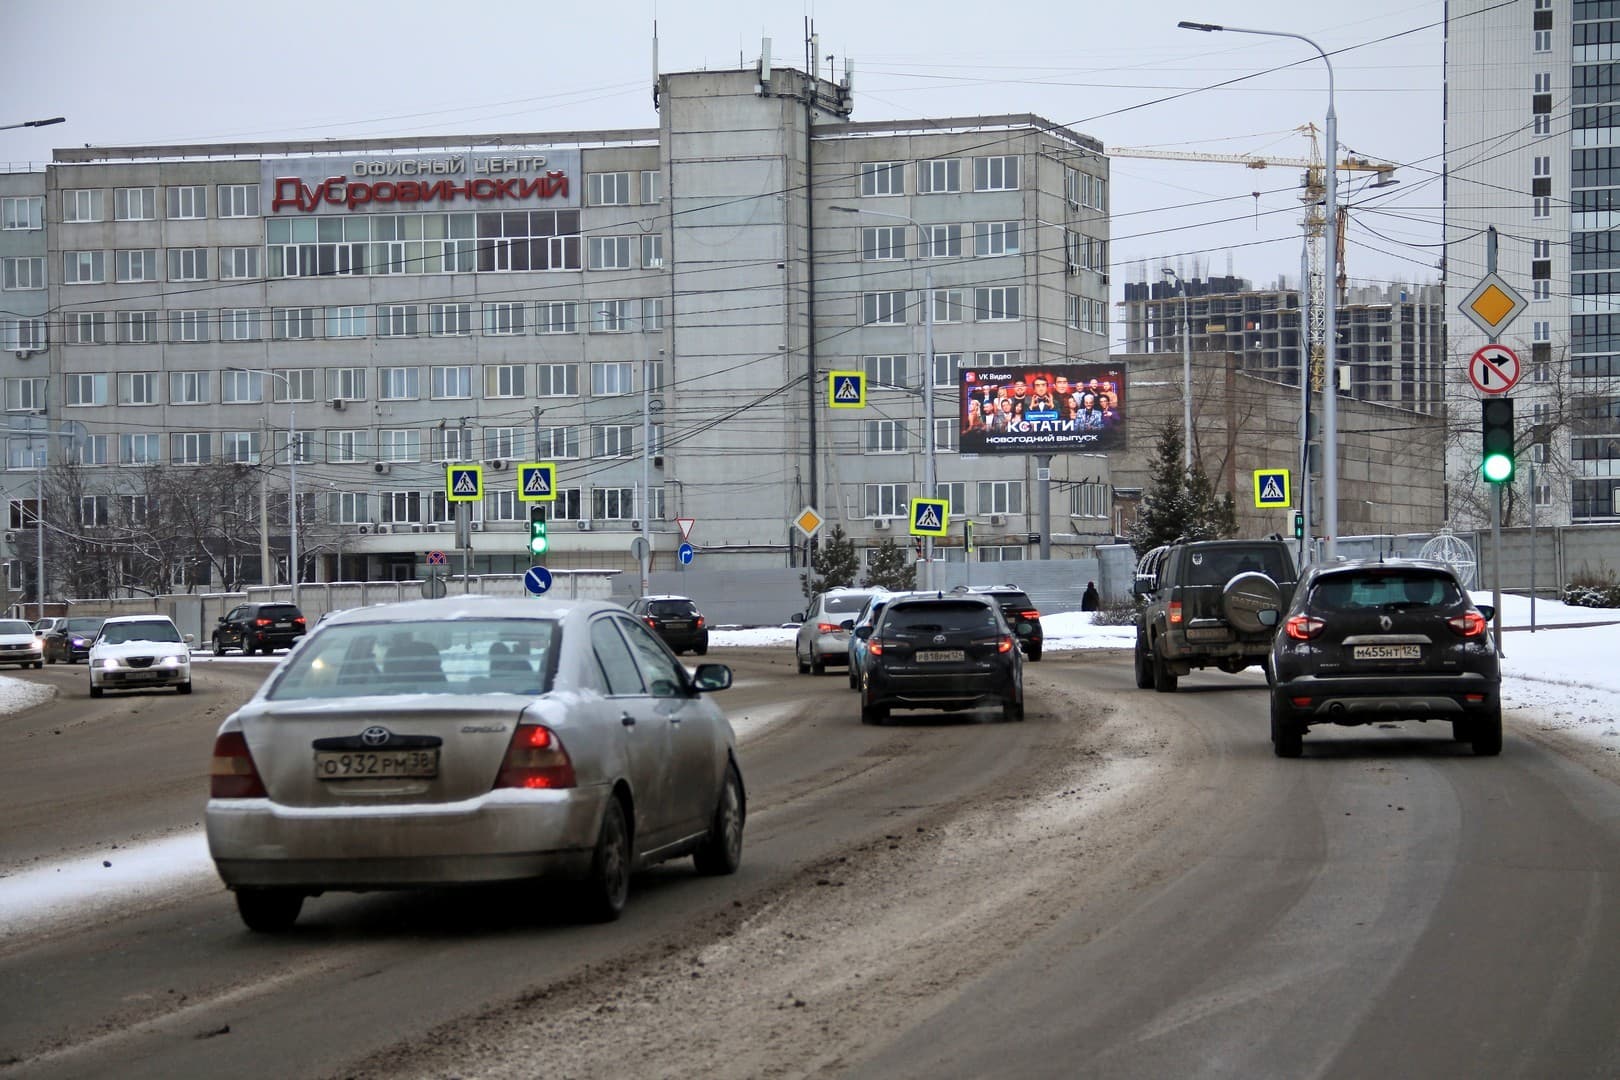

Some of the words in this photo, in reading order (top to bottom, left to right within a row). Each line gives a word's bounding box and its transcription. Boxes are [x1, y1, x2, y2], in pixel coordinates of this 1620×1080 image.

[352, 154, 465, 177] ОФИСНЫЙ
[474, 155, 547, 175] ЦЕНТР
[272, 169, 569, 213] Дубровинский
[989, 373, 1012, 381] Видео
[1007, 420, 1075, 433] КСТАТИ
[986, 434, 1055, 444] НОВОГОДНИЙ
[1056, 434, 1099, 443] ВЫПУСК
